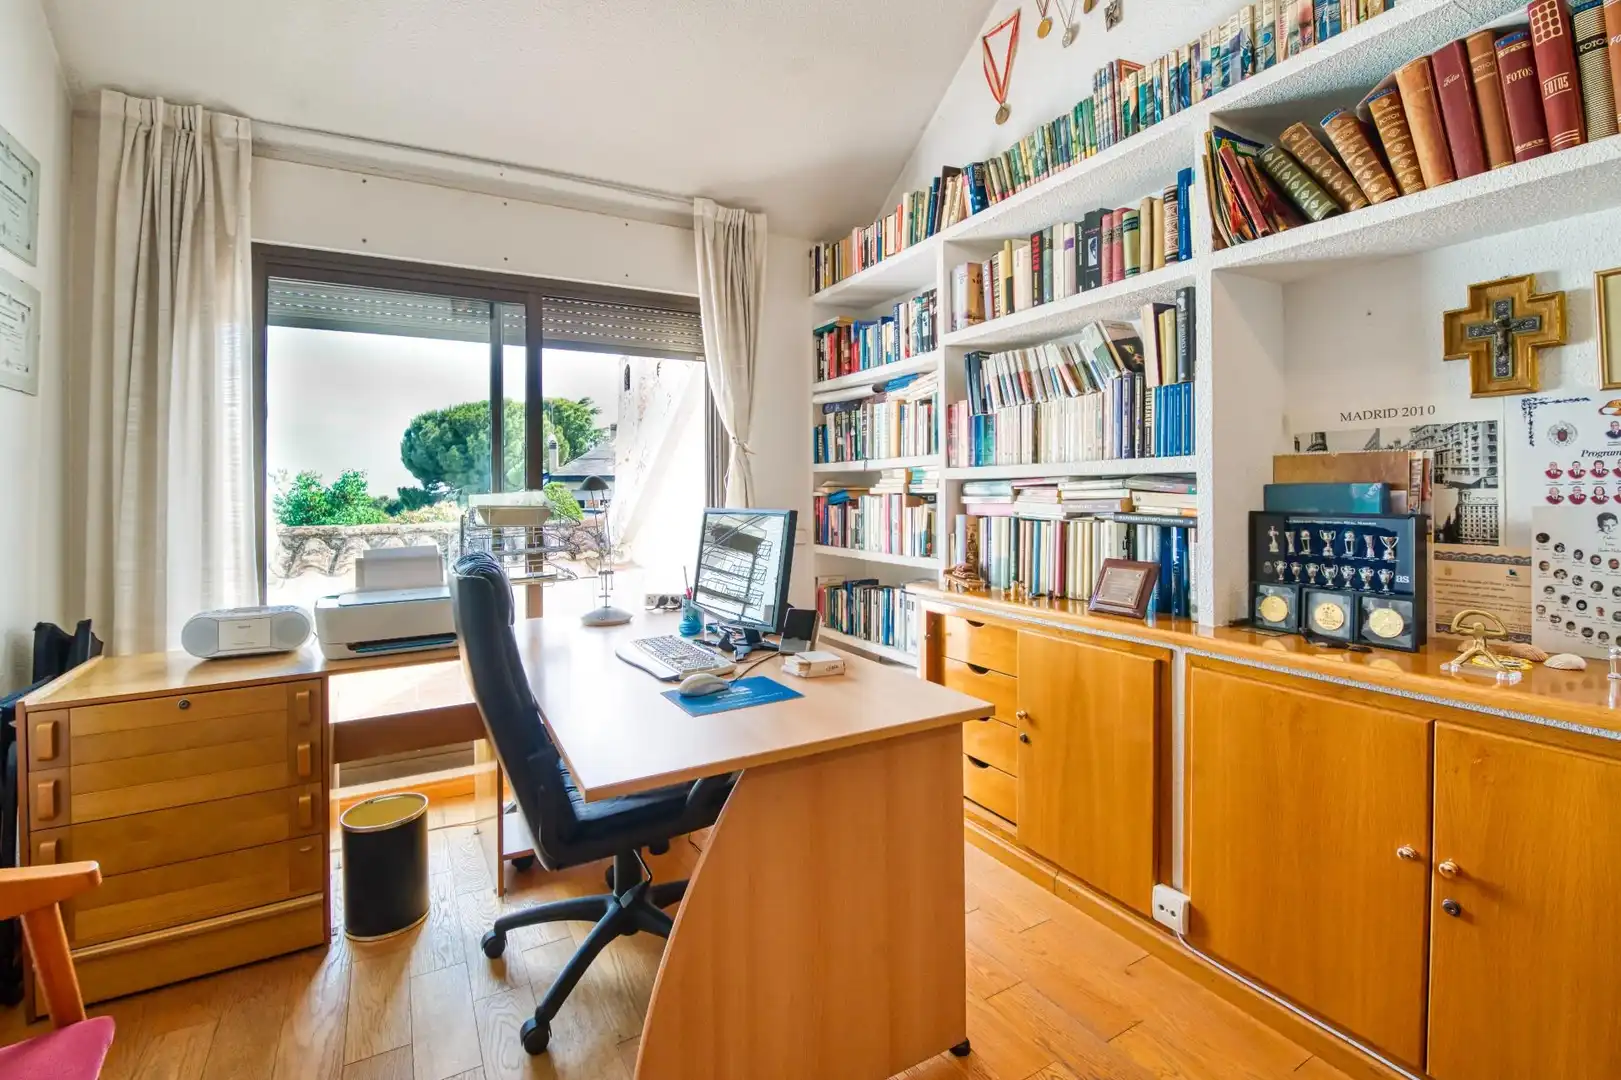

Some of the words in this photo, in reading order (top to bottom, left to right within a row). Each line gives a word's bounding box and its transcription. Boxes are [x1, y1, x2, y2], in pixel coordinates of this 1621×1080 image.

[1506, 67, 1533, 84] FOTOS
[1543, 75, 1569, 96] FOTOS
[1340, 408, 1398, 422] MADRID
[1395, 575, 1409, 583] as
